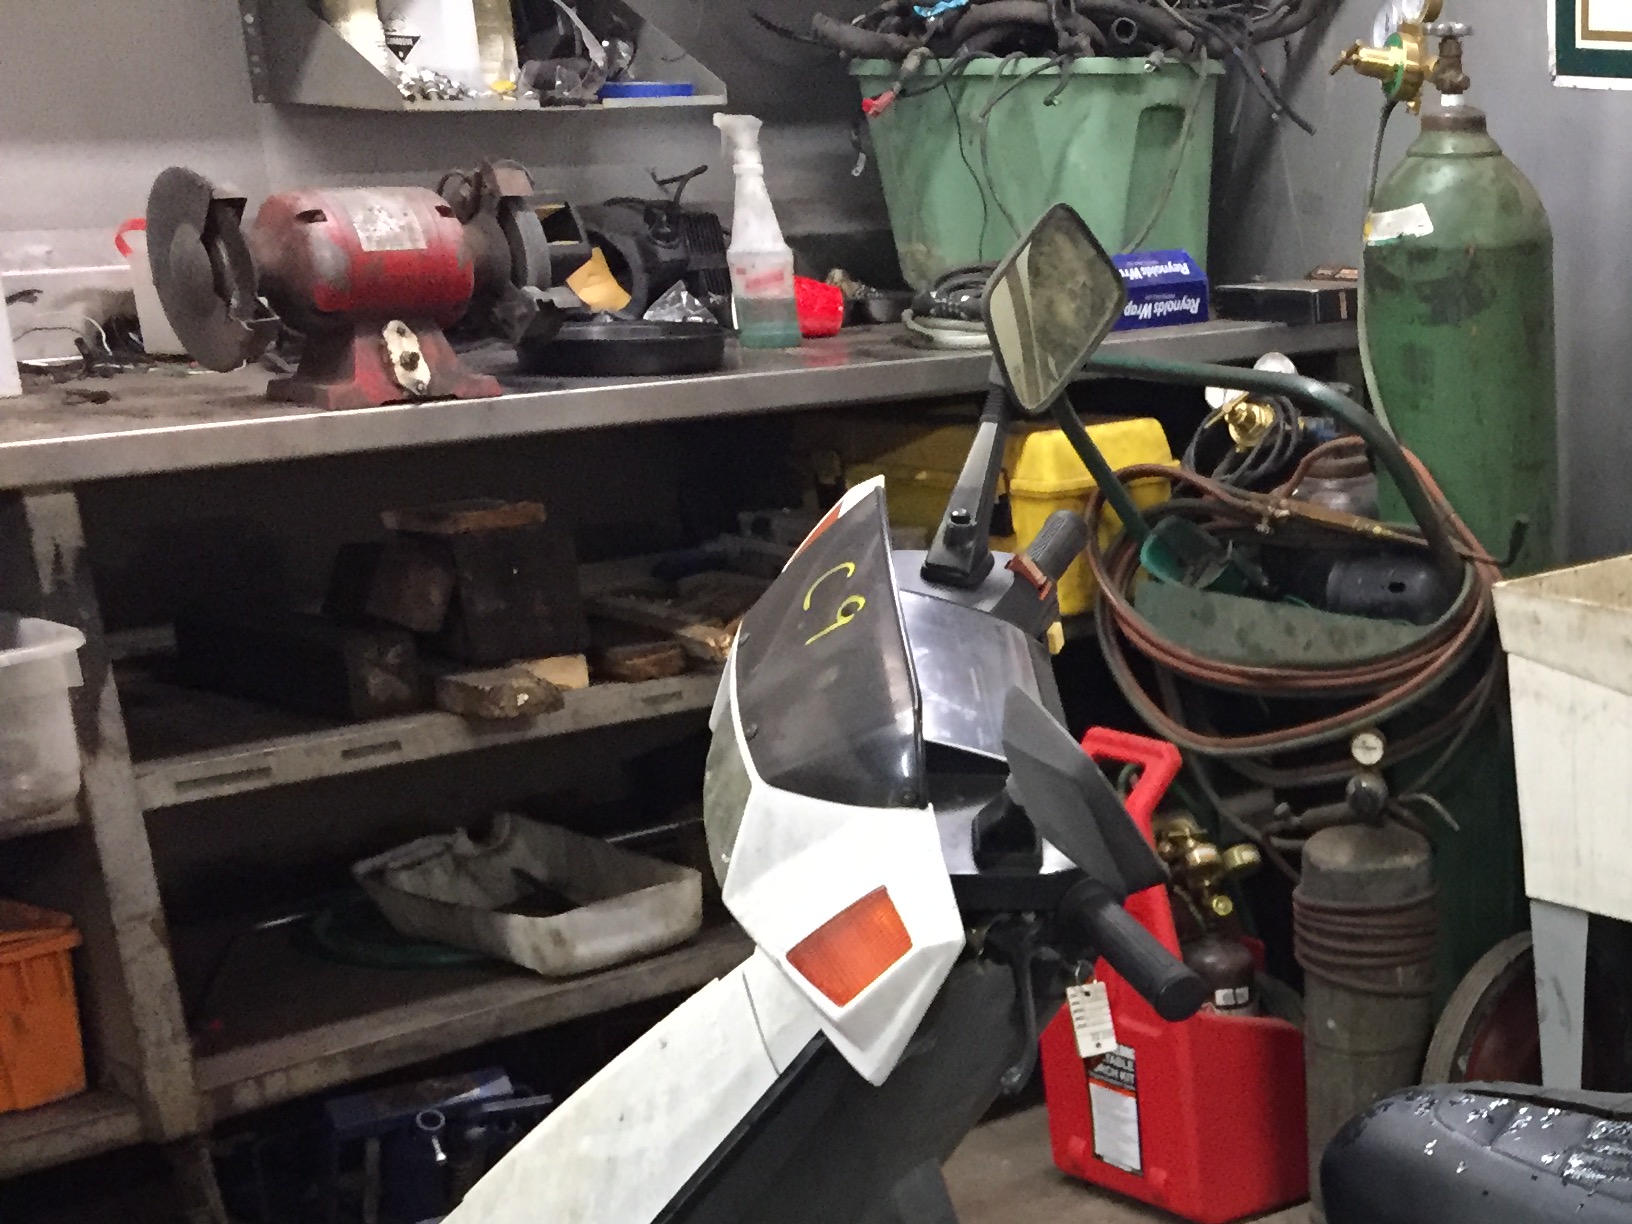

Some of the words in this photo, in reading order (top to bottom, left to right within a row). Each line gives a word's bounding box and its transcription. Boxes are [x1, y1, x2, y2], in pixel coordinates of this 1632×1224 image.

[1141, 261, 1190, 277] Reynolds
[1124, 301, 1152, 320] Wrap
[1153, 295, 1200, 316] Reynolds
